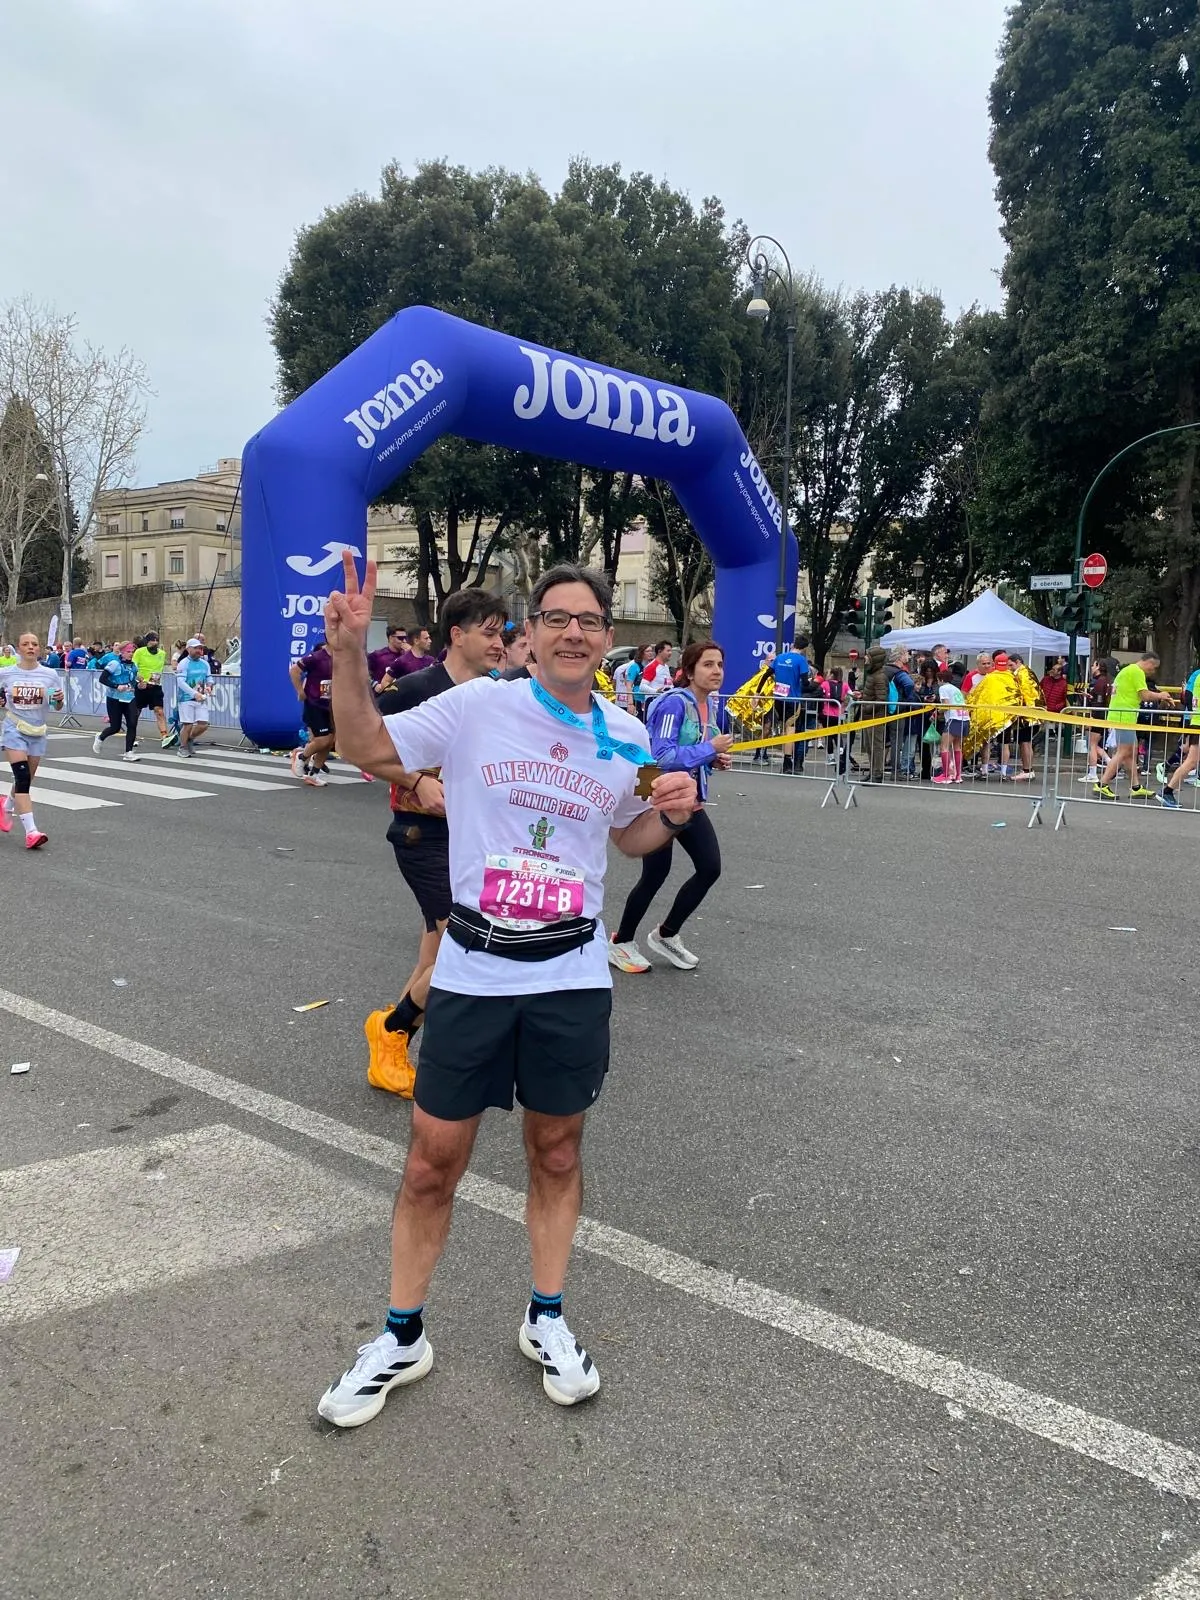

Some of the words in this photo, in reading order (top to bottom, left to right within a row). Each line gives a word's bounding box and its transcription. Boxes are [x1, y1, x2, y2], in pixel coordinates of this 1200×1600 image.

[513, 345, 696, 447] Joma
[377, 400, 447, 462] www.joma-sport.com
[17, 687, 41, 697] 20274
[481, 760, 617, 817] ILNEWYORKESE
[509, 788, 559, 814] RUNNING
[558, 800, 590, 822] TEAM
[512, 846, 560, 863] STRONGERS
[495, 878, 572, 913] 1231-B
[511, 871, 560, 887] STAFFETTA
